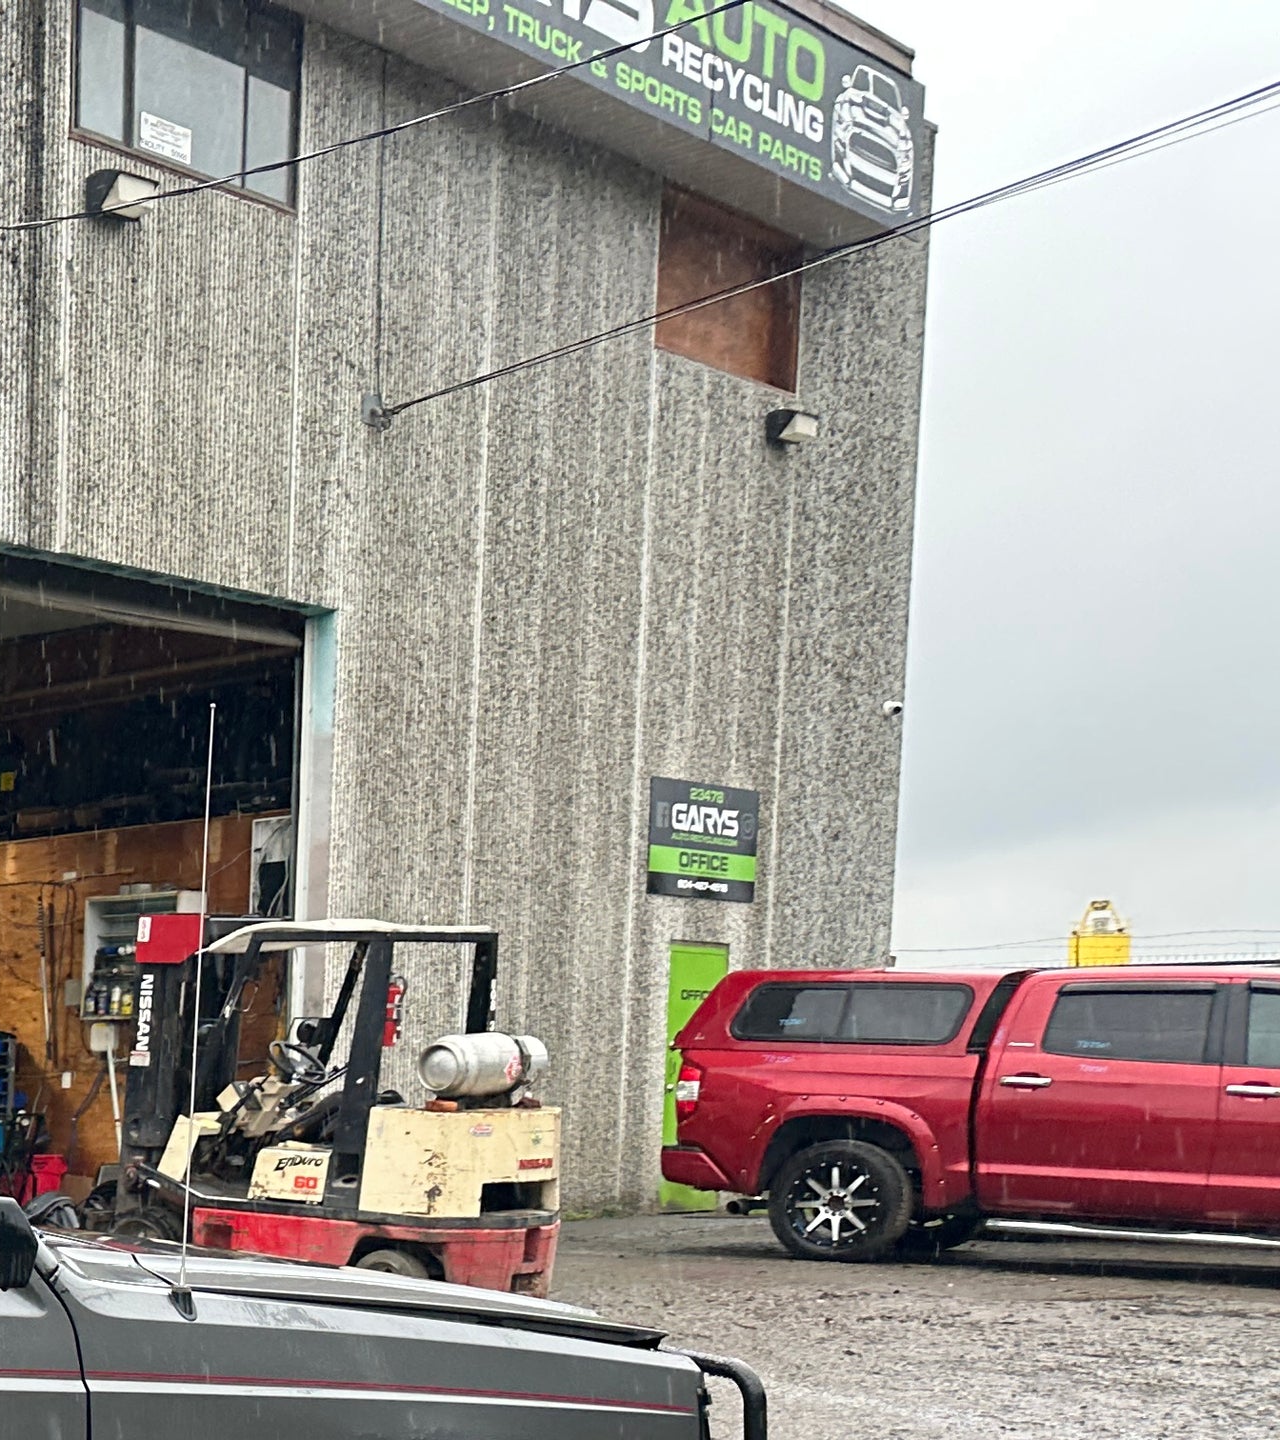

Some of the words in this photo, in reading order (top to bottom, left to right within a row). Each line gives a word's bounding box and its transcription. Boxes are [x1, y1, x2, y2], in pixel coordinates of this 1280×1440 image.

[665, 0, 826, 102] AUTO
[502, 5, 584, 62] TRUCK
[590, 50, 609, 79] &
[615, 61, 703, 125] SPORTS
[710, 107, 754, 149] CAR
[757, 131, 824, 182] PARTS
[661, 32, 825, 143] RECYCLING
[671, 803, 740, 837] GARYS
[678, 851, 729, 872] OFFICE
[136, 974, 155, 1051] NISSAN
[680, 989, 711, 1000] OFFIC
[294, 1175, 318, 1189] 60
